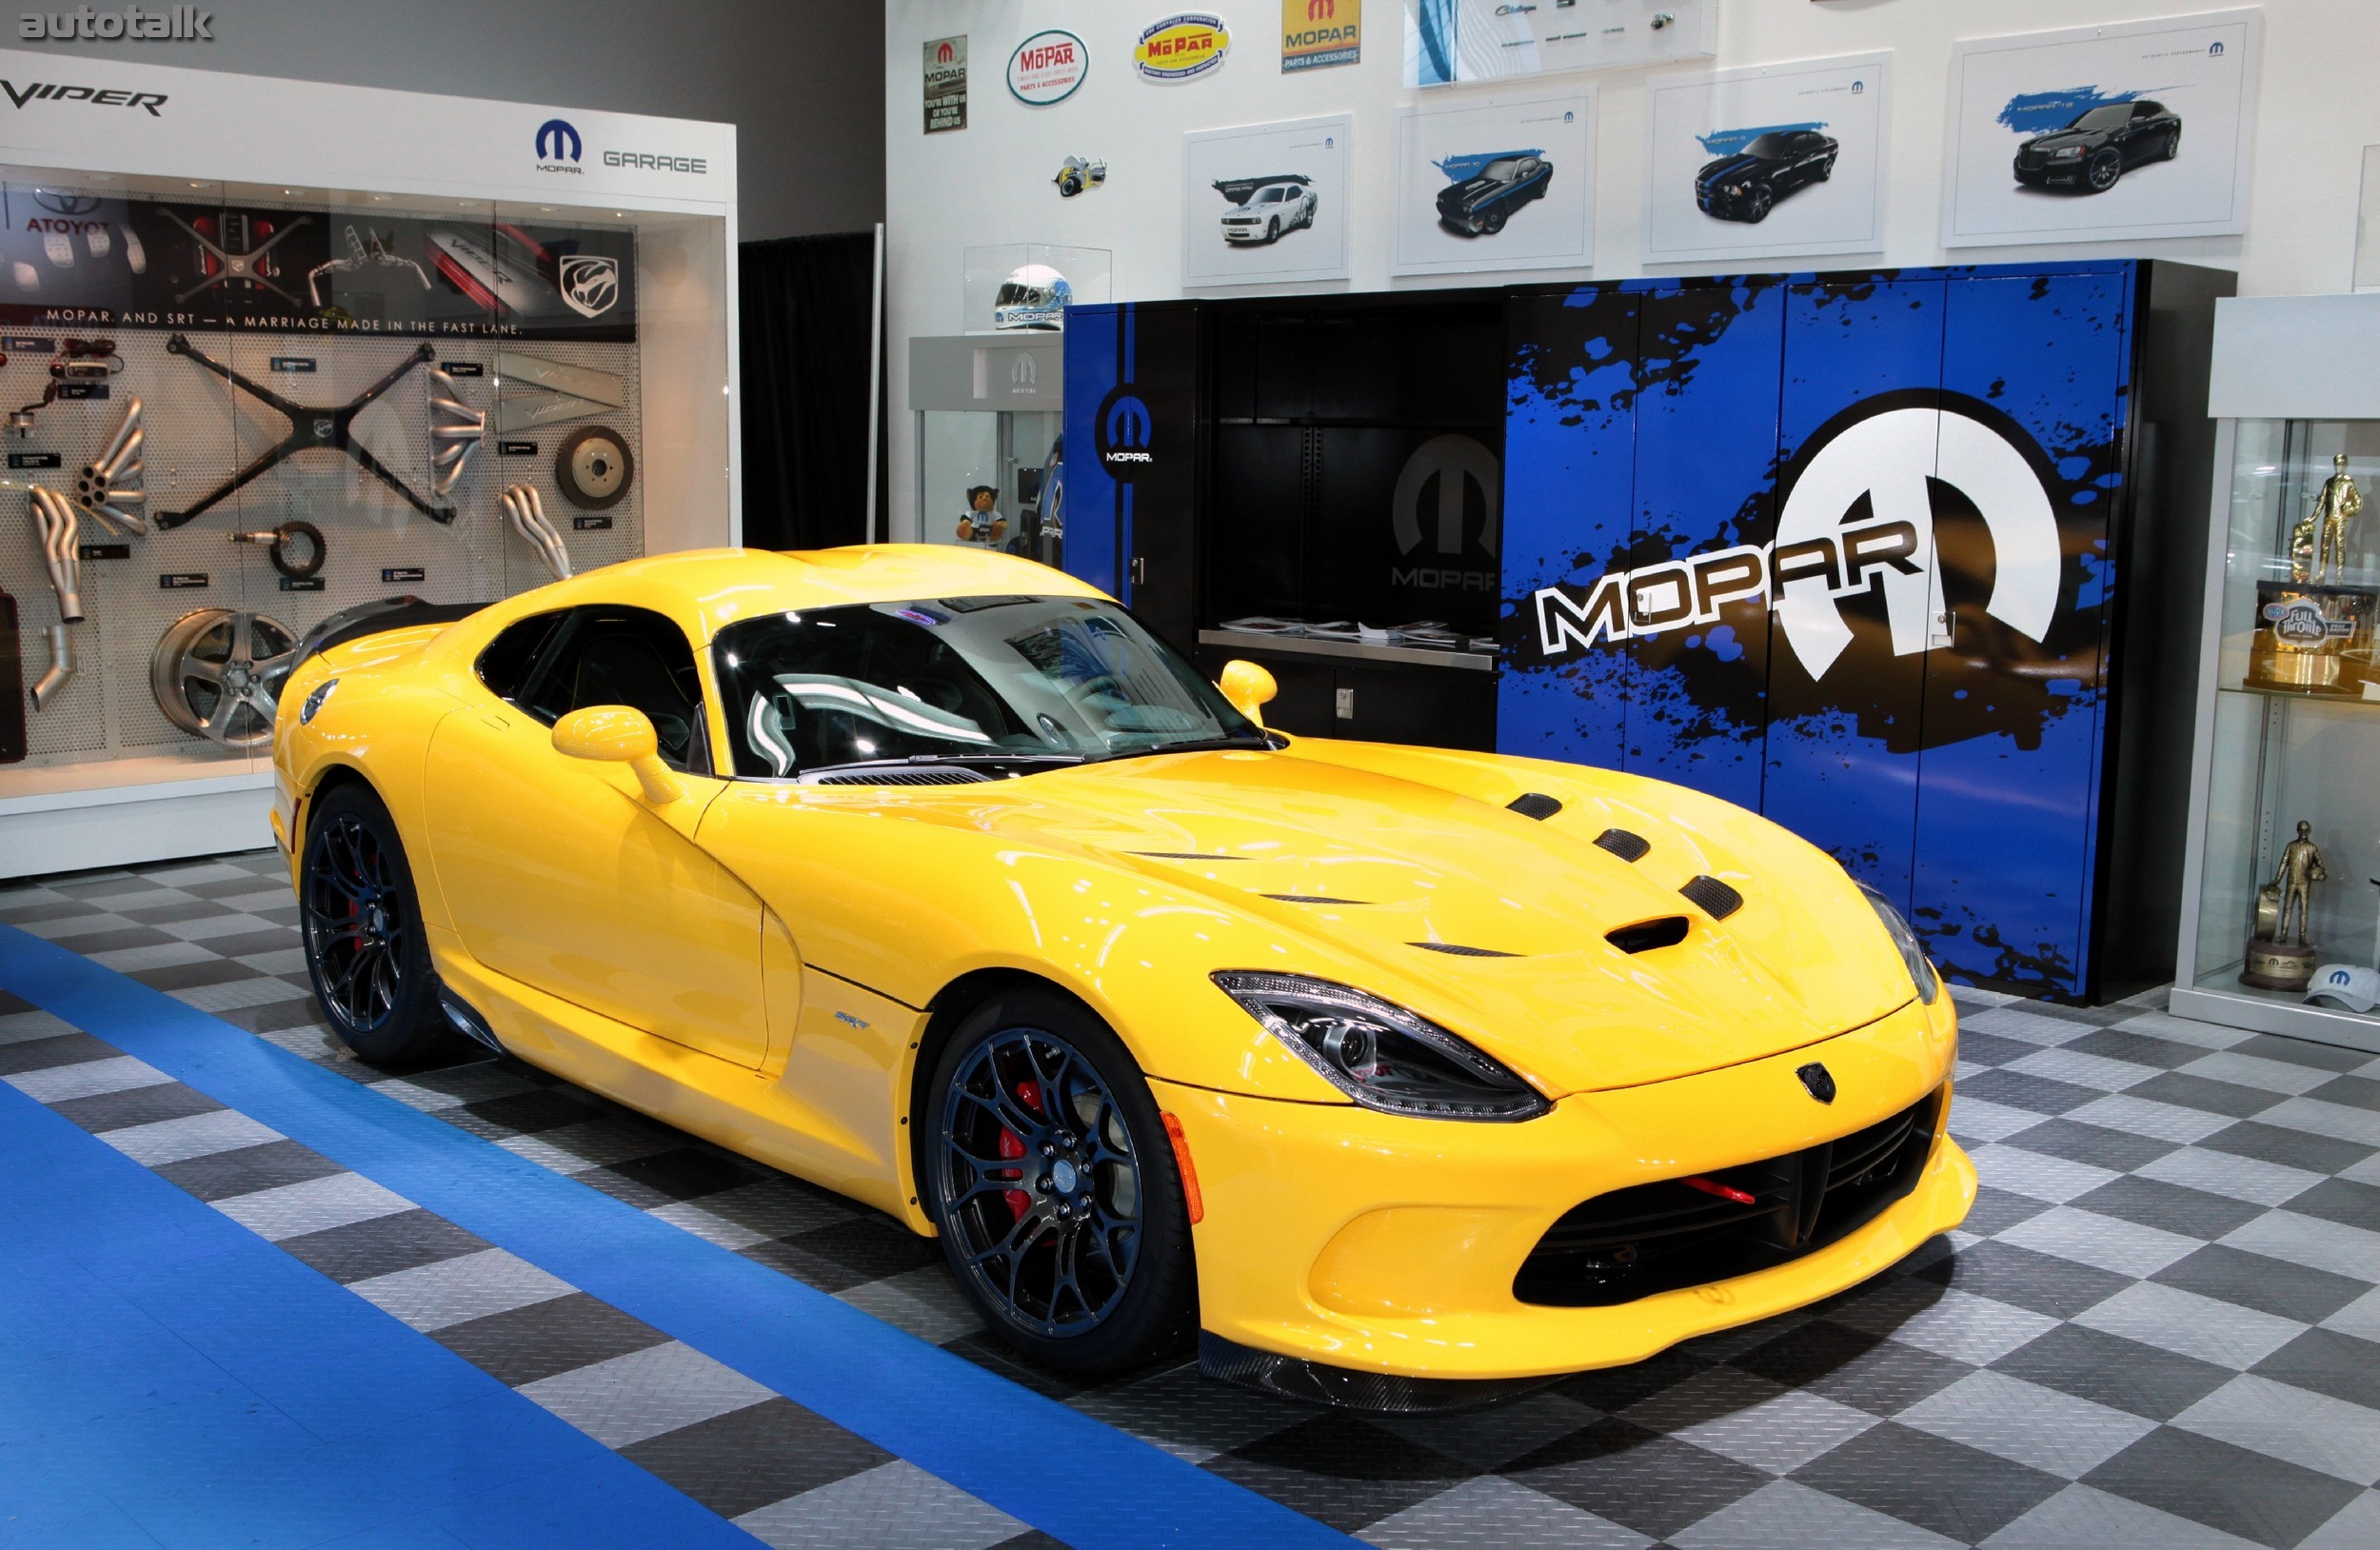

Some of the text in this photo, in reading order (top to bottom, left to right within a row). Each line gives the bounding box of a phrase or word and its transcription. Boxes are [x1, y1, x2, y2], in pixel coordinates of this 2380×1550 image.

[1286, 25, 1357, 48] MOPAR
[1285, 50, 1358, 69] PARTS & ACCESSORIES
[924, 68, 966, 84] MOPAR
[1020, 82, 1037, 91] PARTS
[1041, 76, 1076, 88] ACCESSORIES
[0, 78, 169, 117] VIPER
[924, 93, 966, 109] YOU'RE WITH US
[933, 106, 958, 118] OR YOU'RE
[929, 115, 962, 129] BEHIND US
[604, 150, 706, 174] GARAGE
[450, 238, 514, 285] VIPER
[123, 312, 158, 324] AND
[168, 312, 195, 325] SRT
[227, 316, 236, 326] A
[245, 316, 328, 329] MARRIAGE
[337, 319, 380, 330] MADE
[388, 321, 403, 331] IN
[411, 321, 435, 332] THE
[444, 323, 475, 334] FAST
[483, 324, 523, 335] LANE.
[1008, 311, 1063, 322] MOPAR
[1535, 520, 1926, 656] MOPAR
[2267, 606, 2286, 617] NHRA
